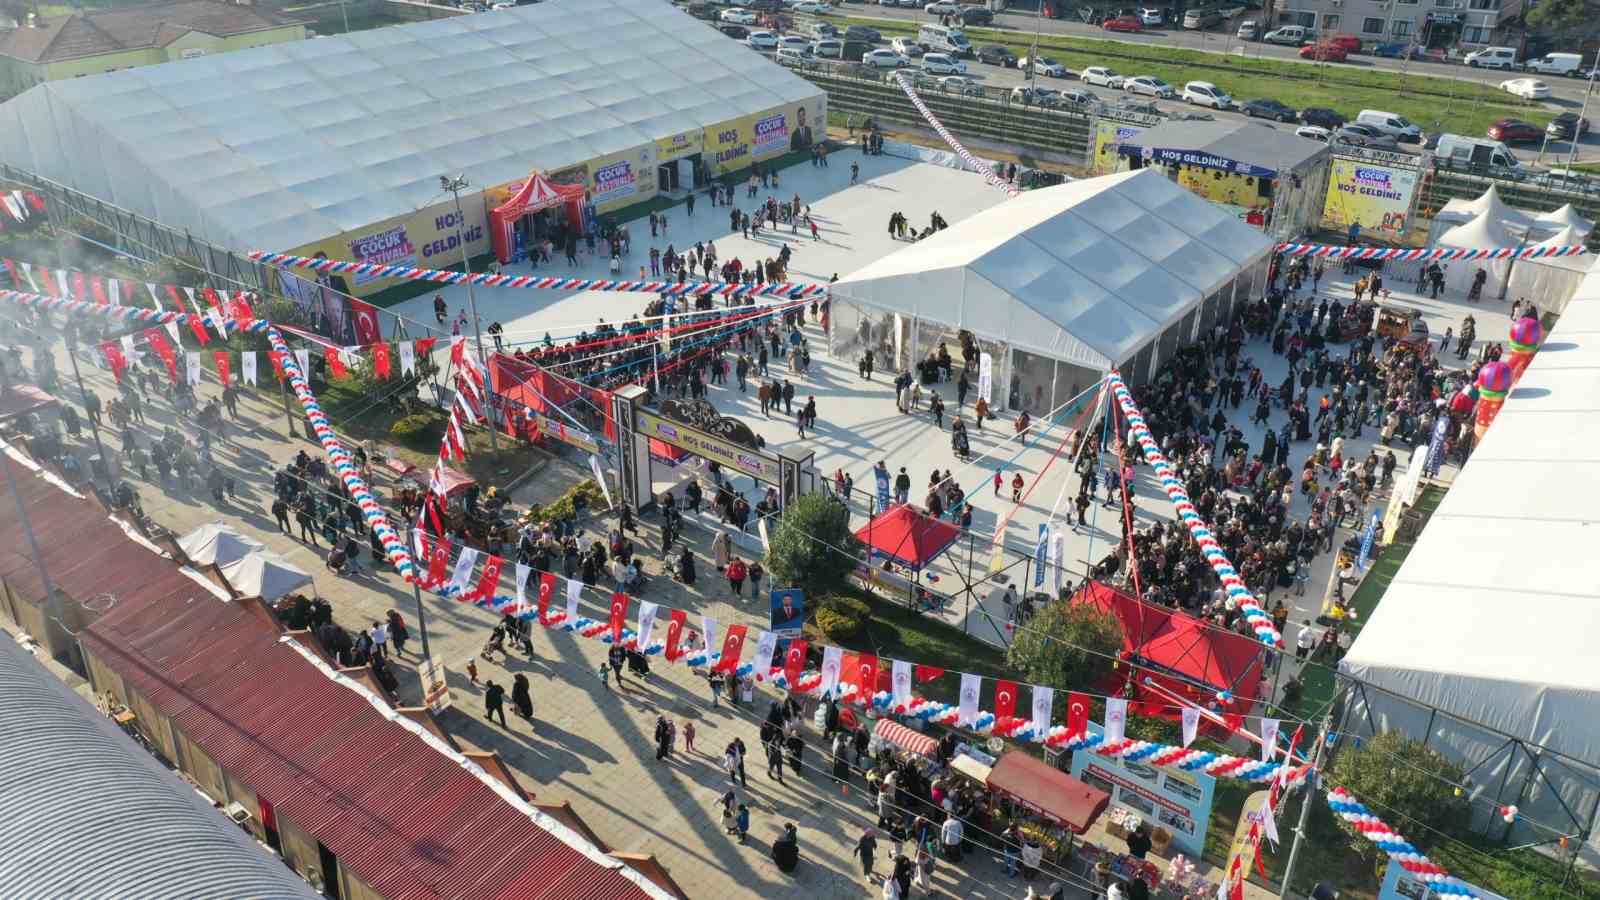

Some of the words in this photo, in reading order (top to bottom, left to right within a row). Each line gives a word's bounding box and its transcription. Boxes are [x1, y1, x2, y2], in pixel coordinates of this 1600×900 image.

[718, 129, 738, 144] HOŞ
[1162, 149, 1181, 161] HOŞ
[1184, 153, 1230, 168] GELDİNİZ
[1338, 183, 1356, 195] HOŞ
[1360, 186, 1402, 200] GELDİNİZ
[360, 232, 401, 259] ÇOCUK
[683, 434, 699, 448] HOŞ
[700, 440, 735, 460] GELDİNİZ
